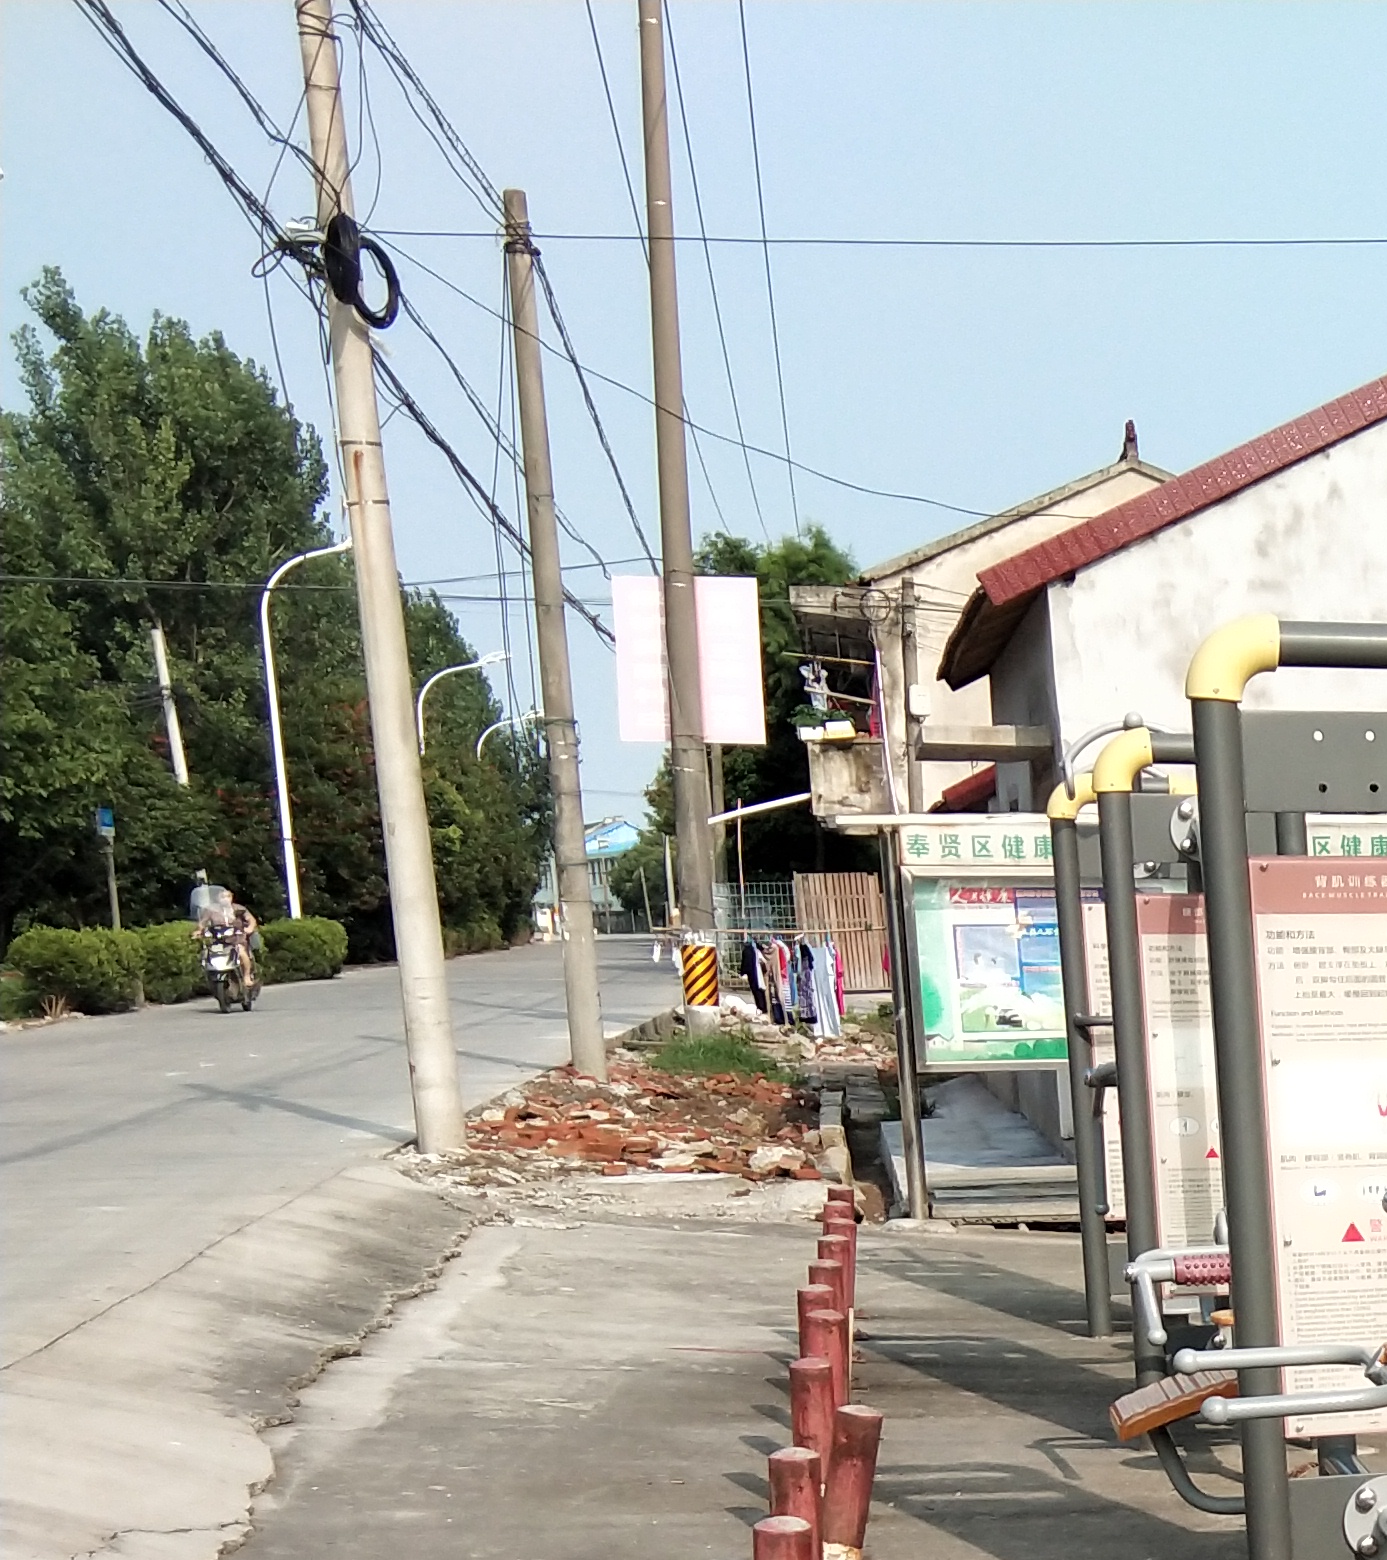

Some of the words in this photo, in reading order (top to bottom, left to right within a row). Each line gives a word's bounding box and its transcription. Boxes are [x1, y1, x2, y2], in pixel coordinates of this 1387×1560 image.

[906, 833, 1053, 859] 奉贤区健康
